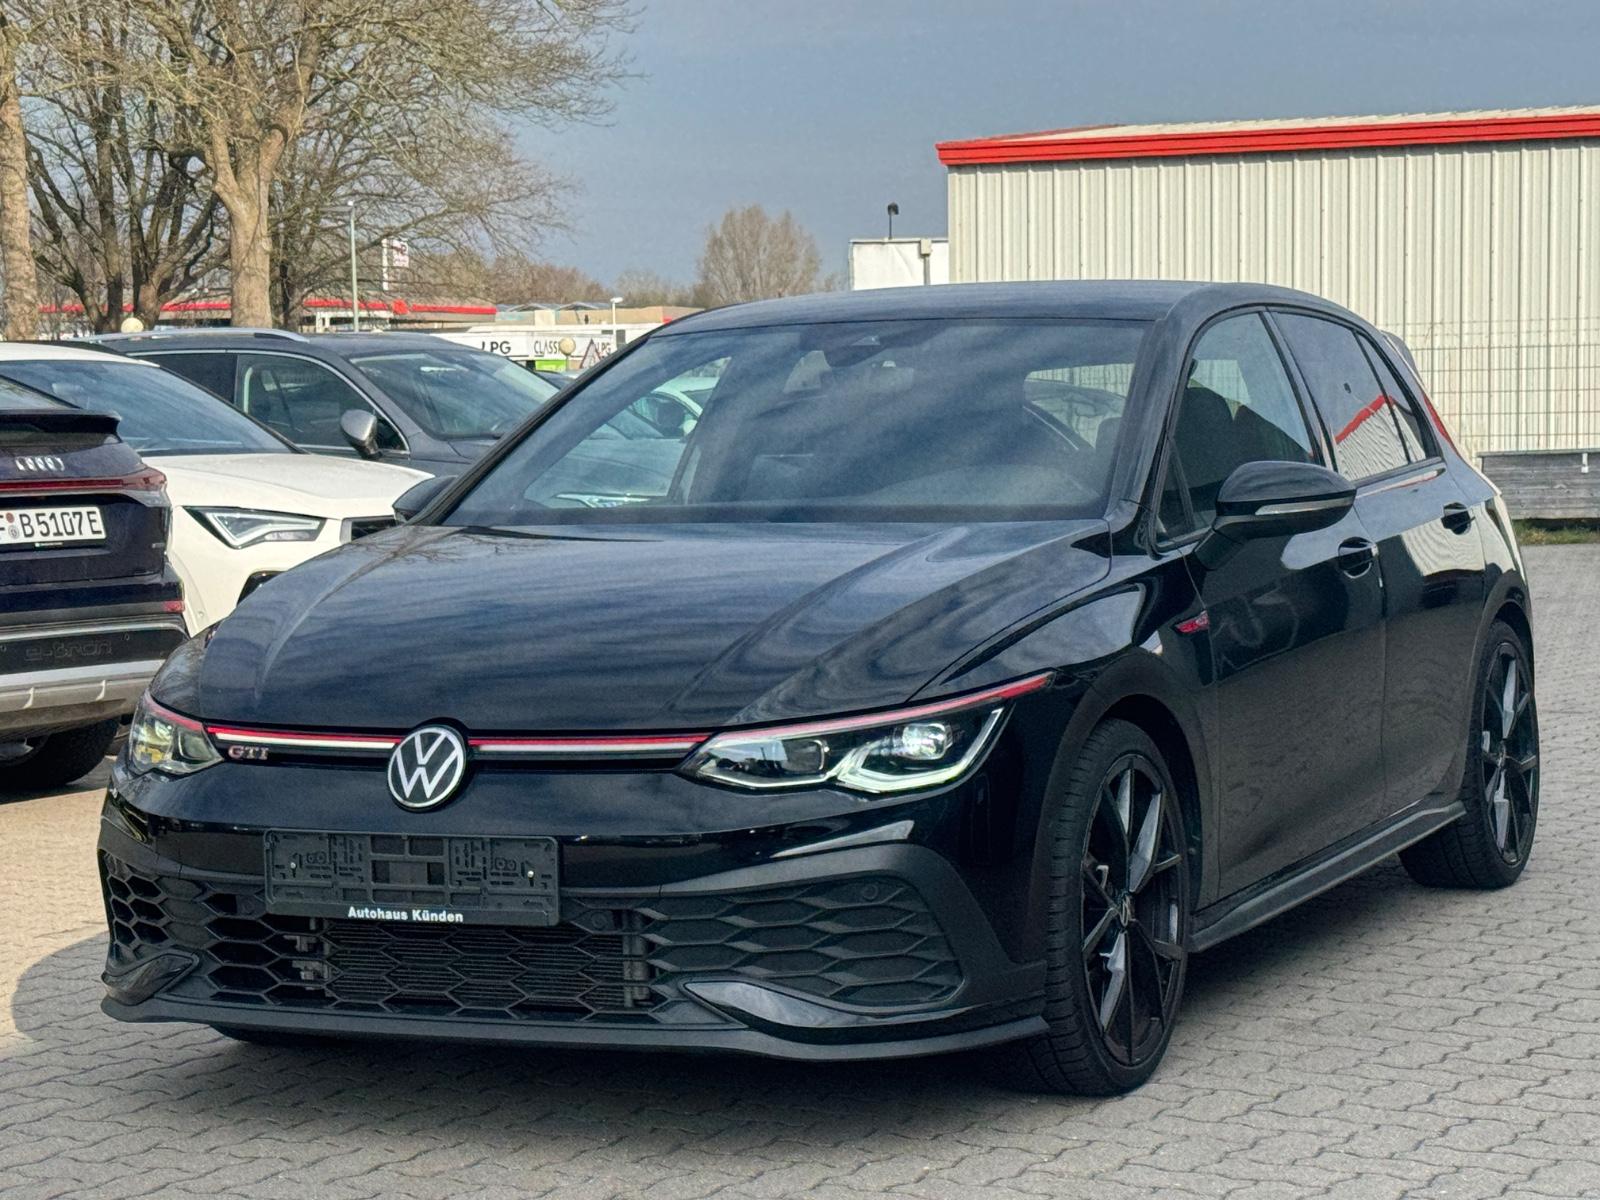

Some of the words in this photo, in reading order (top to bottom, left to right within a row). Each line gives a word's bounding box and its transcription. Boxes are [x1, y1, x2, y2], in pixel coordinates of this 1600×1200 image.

[228, 745, 269, 760] GTI
[347, 905, 408, 922] Autohaus
[411, 908, 464, 924] Künden
